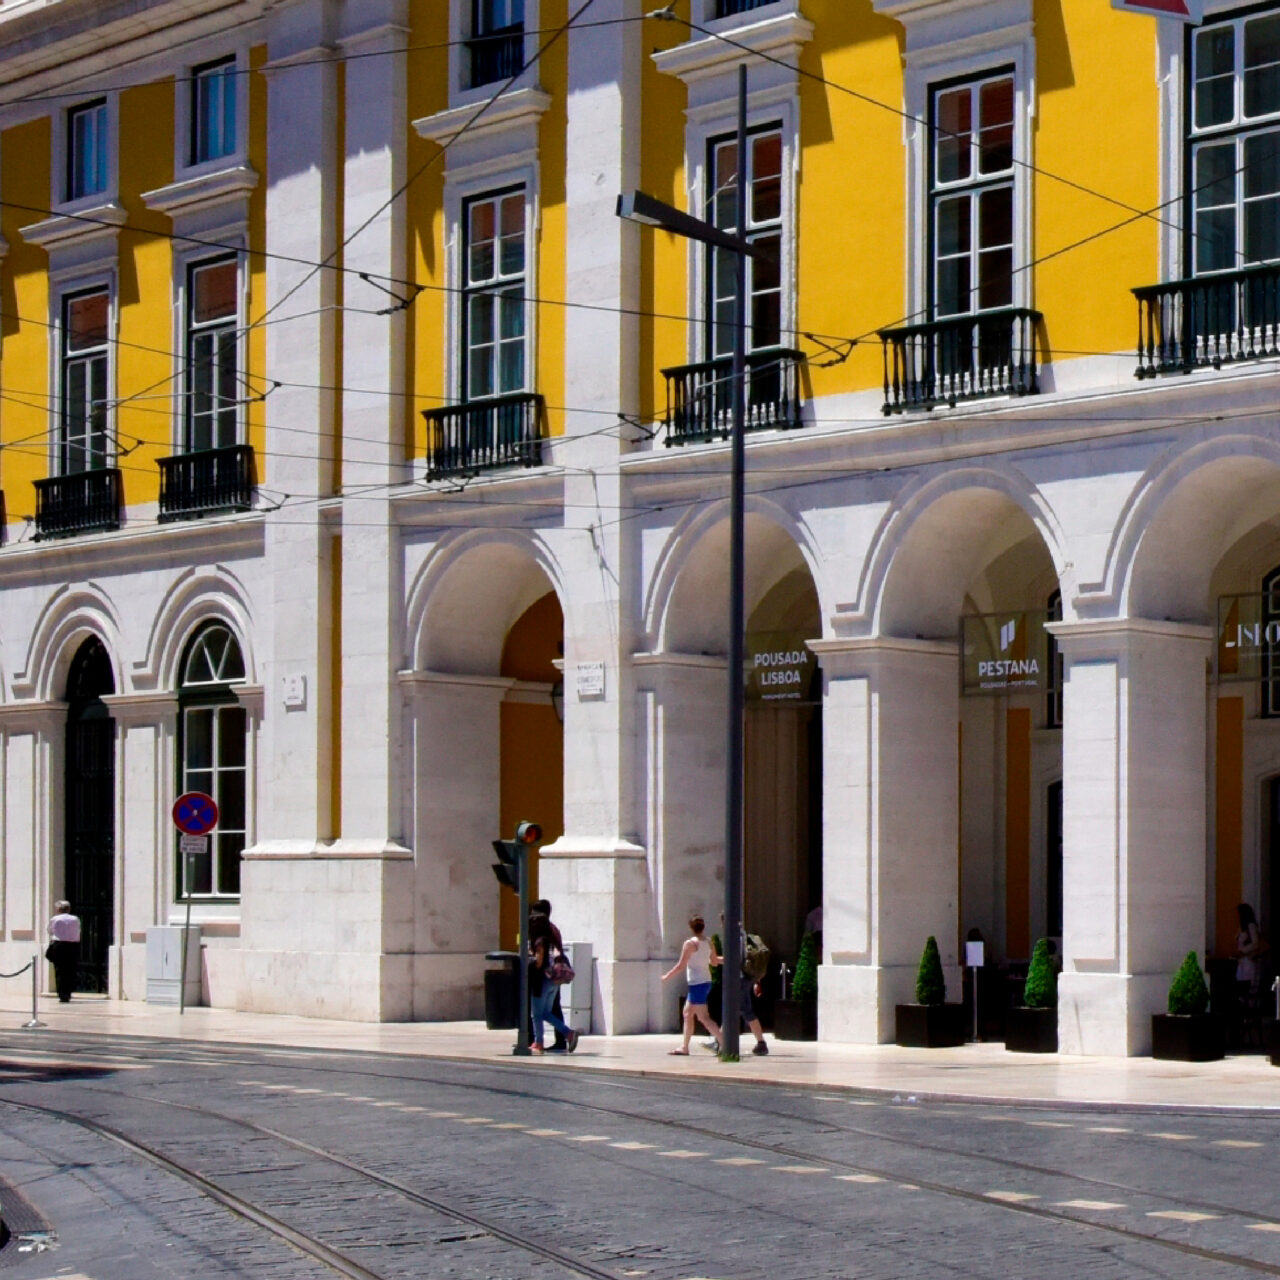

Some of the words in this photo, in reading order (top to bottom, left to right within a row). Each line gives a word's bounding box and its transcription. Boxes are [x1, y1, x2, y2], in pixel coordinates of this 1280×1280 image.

[754, 651, 808, 668] POUSADA
[978, 659, 1039, 677] PESTANA
[761, 670, 801, 685] LISBOA
